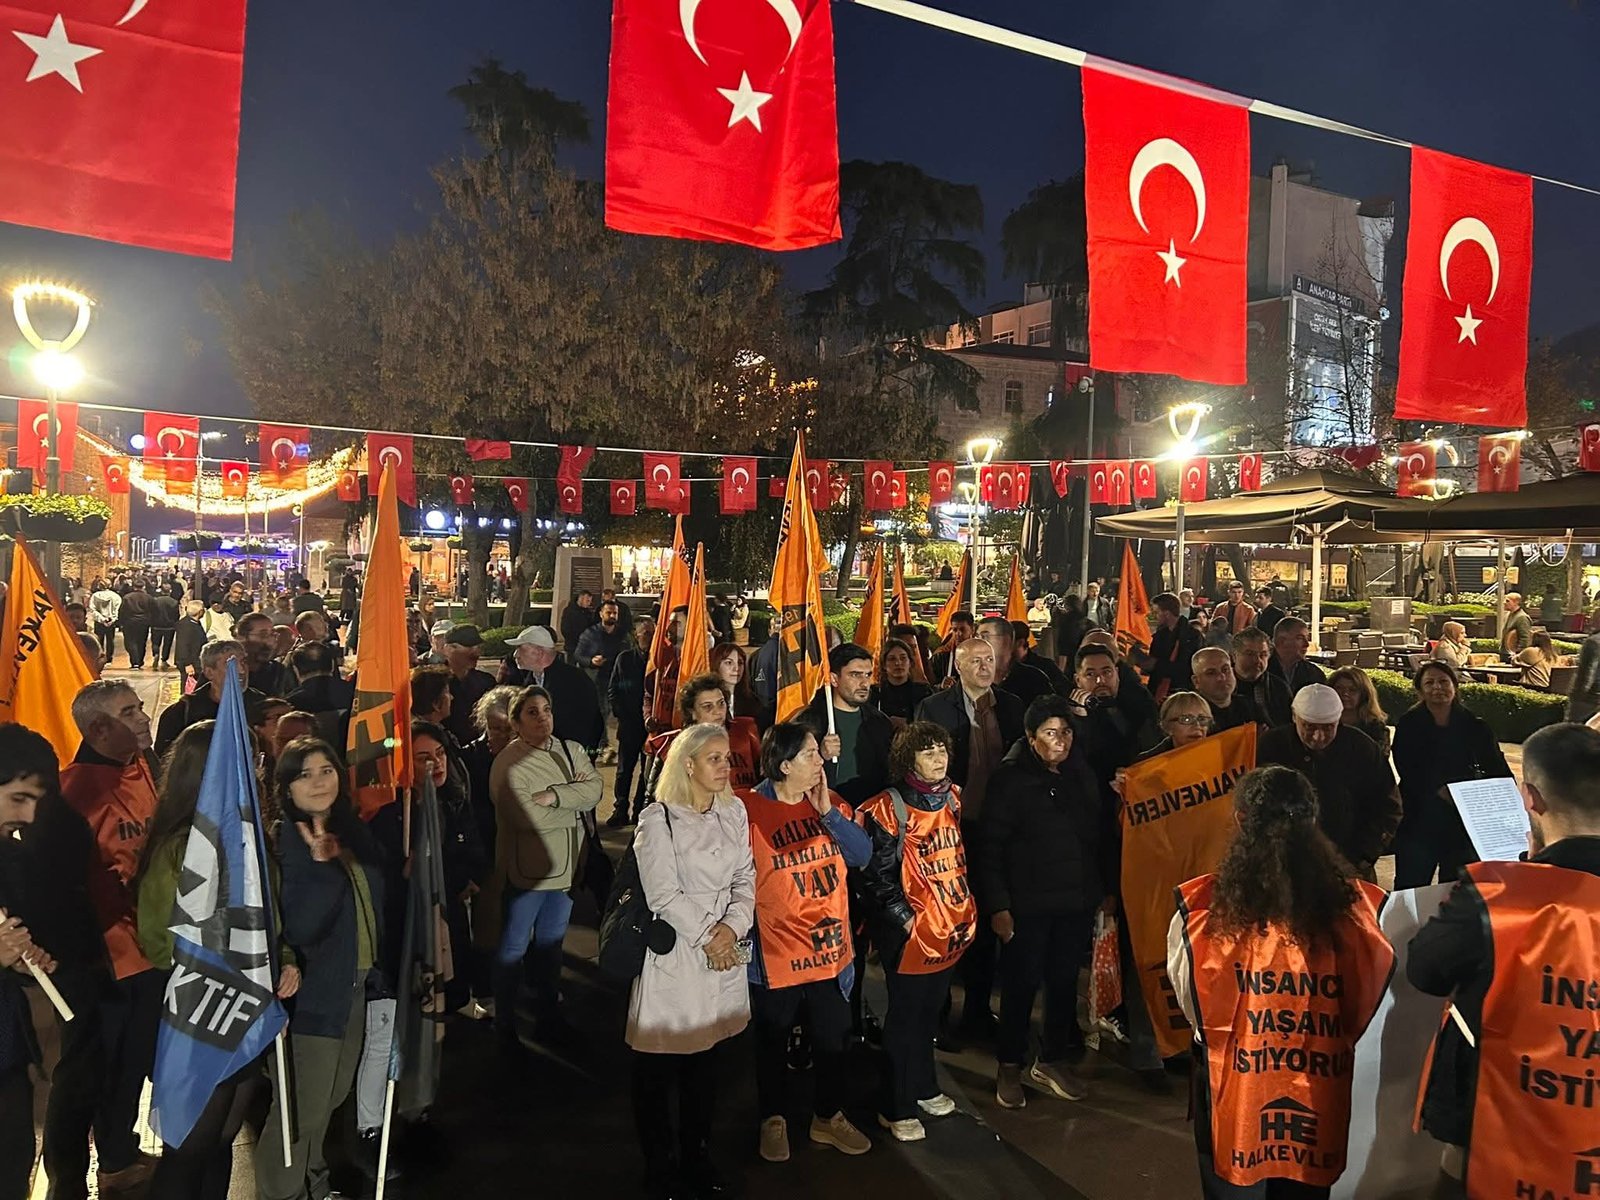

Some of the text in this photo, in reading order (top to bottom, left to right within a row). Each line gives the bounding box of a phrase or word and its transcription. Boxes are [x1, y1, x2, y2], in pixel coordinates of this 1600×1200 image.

[1234, 961, 1344, 999] İNSANC
[1247, 1009, 1342, 1040] YAŞAM
[1232, 1038, 1352, 1078] İSTİYORU
[1520, 1054, 1600, 1108] İSTİ
[1260, 1111, 1319, 1146] HE
[1231, 1143, 1340, 1169] HALKEVLE
